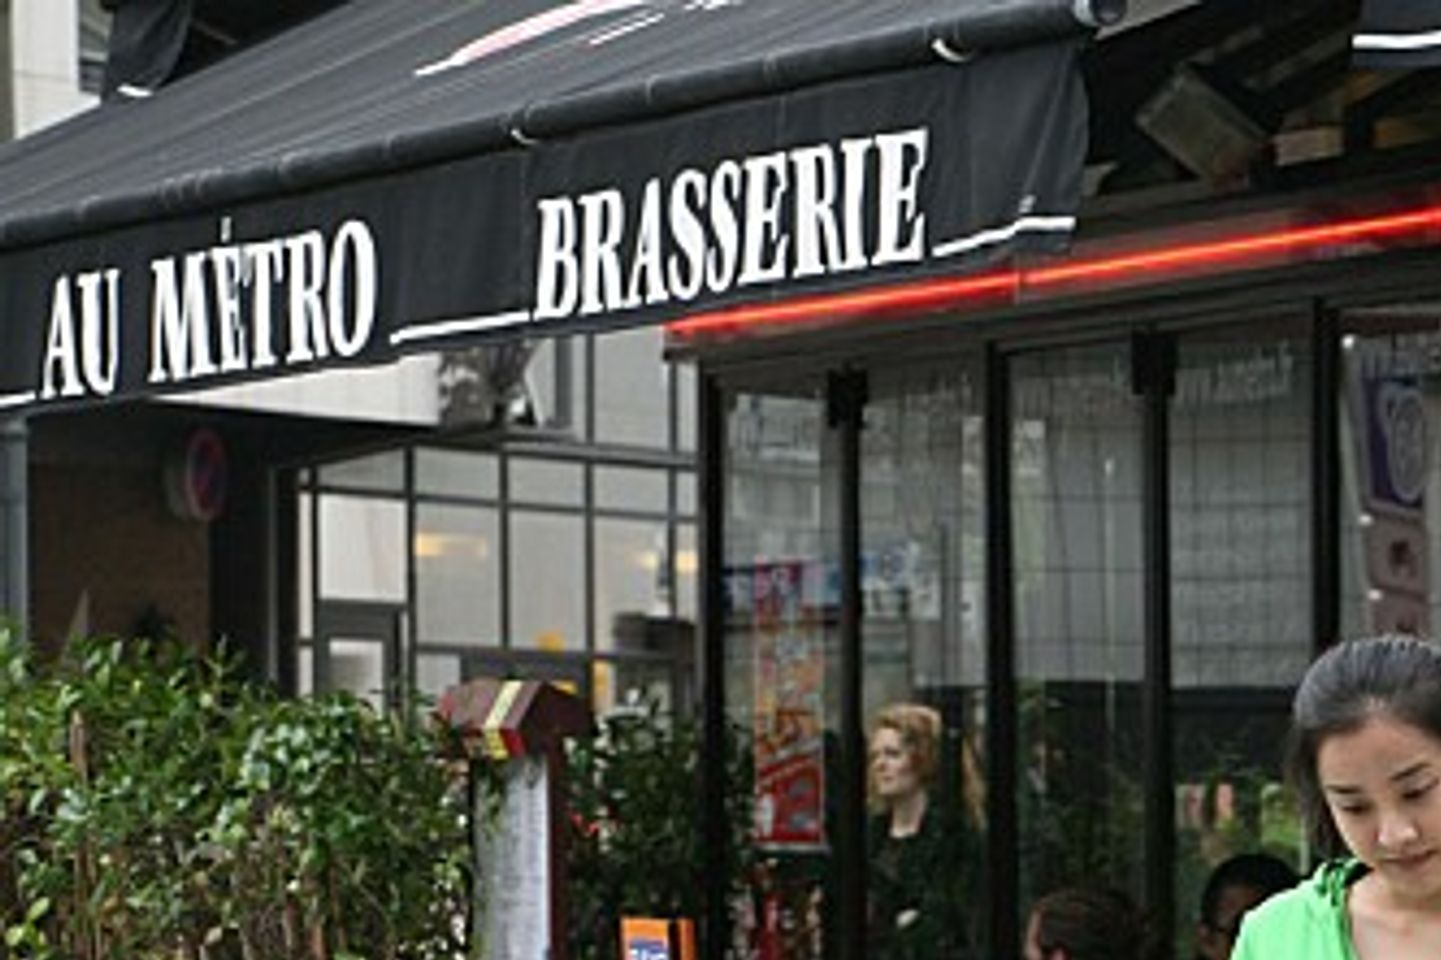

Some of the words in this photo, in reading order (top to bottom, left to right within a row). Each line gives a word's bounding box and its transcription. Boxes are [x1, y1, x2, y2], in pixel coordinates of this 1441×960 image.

[40, 268, 120, 399] AU
[148, 216, 375, 382] MÉTRO
[533, 127, 929, 320] BRASSERIE
